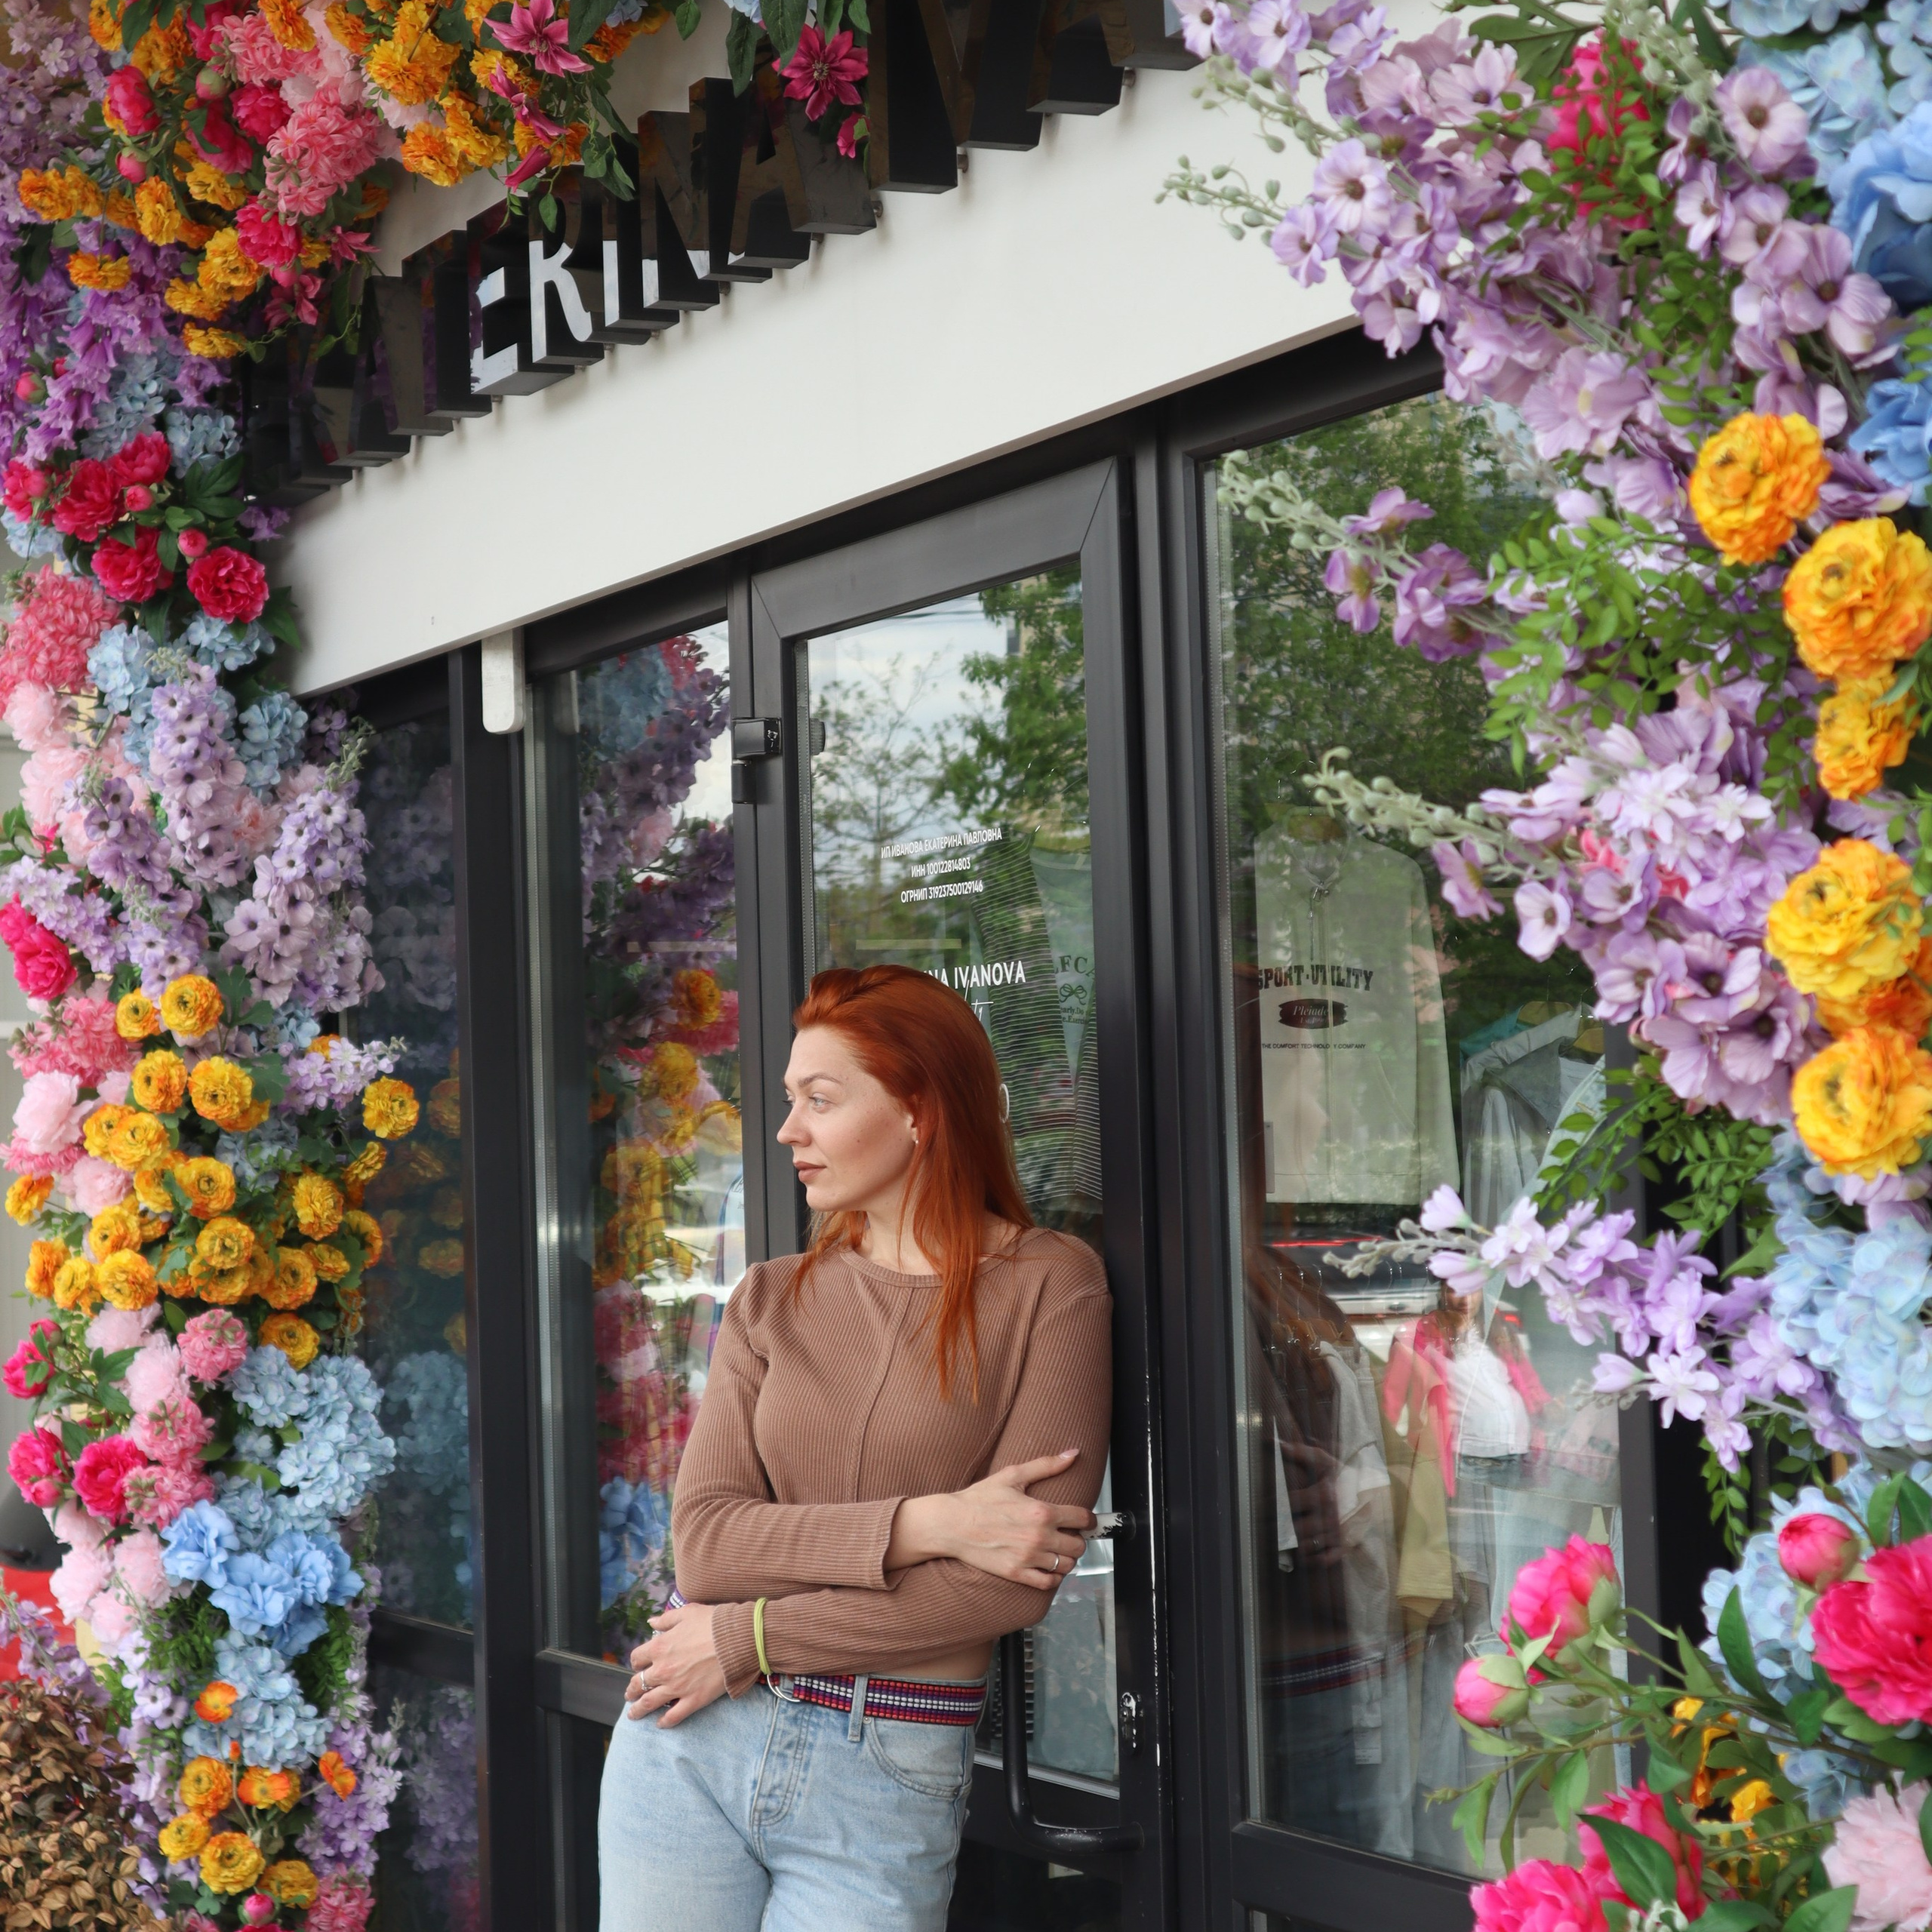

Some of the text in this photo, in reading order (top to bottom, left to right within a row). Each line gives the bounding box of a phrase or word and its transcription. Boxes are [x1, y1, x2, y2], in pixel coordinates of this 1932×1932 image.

[881, 828, 1003, 859] ИП ИВАНОВА ЕКАТЕРИНА ПАВЛОВНА
[911, 857, 971, 878] ИНН 100122814803
[900, 880, 983, 903] ОГРНИП 319237500129146
[954, 960, 1026, 989] IVANOVA
